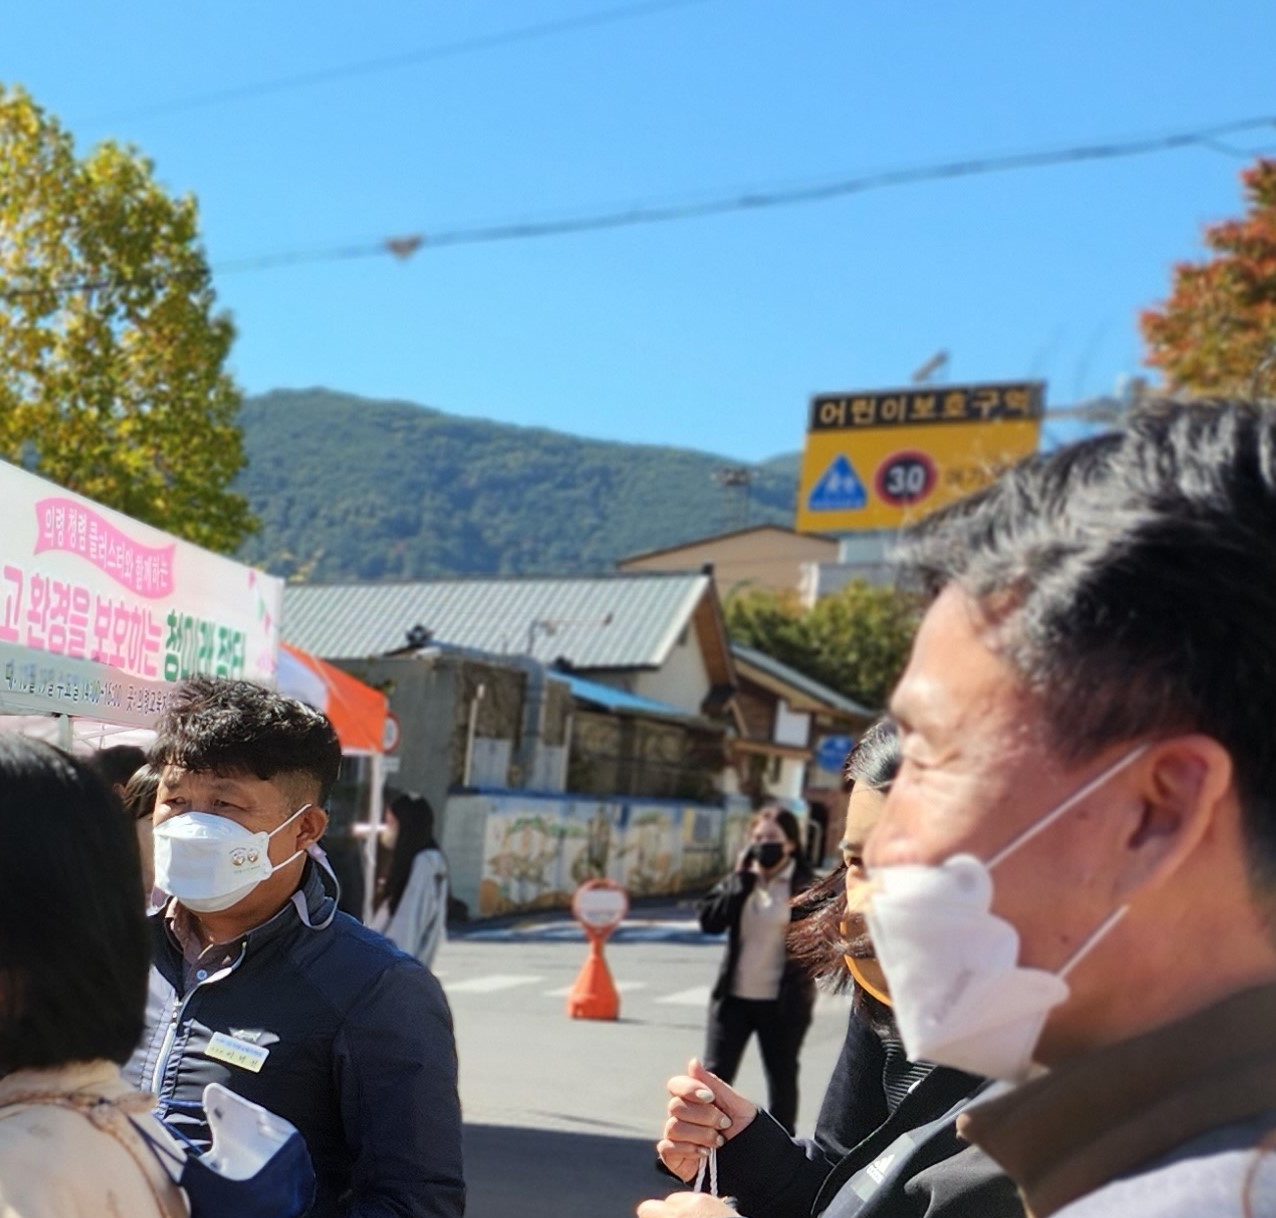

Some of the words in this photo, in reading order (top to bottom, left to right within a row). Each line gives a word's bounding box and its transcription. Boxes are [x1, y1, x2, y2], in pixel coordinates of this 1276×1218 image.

[819, 388, 1030, 425] 어린이보호구역
[887, 465, 926, 494] 30
[44, 506, 66, 547] 의령
[27, 572, 91, 660] 환경을
[93, 594, 163, 677] 보호하는
[164, 608, 216, 682] 청미래
